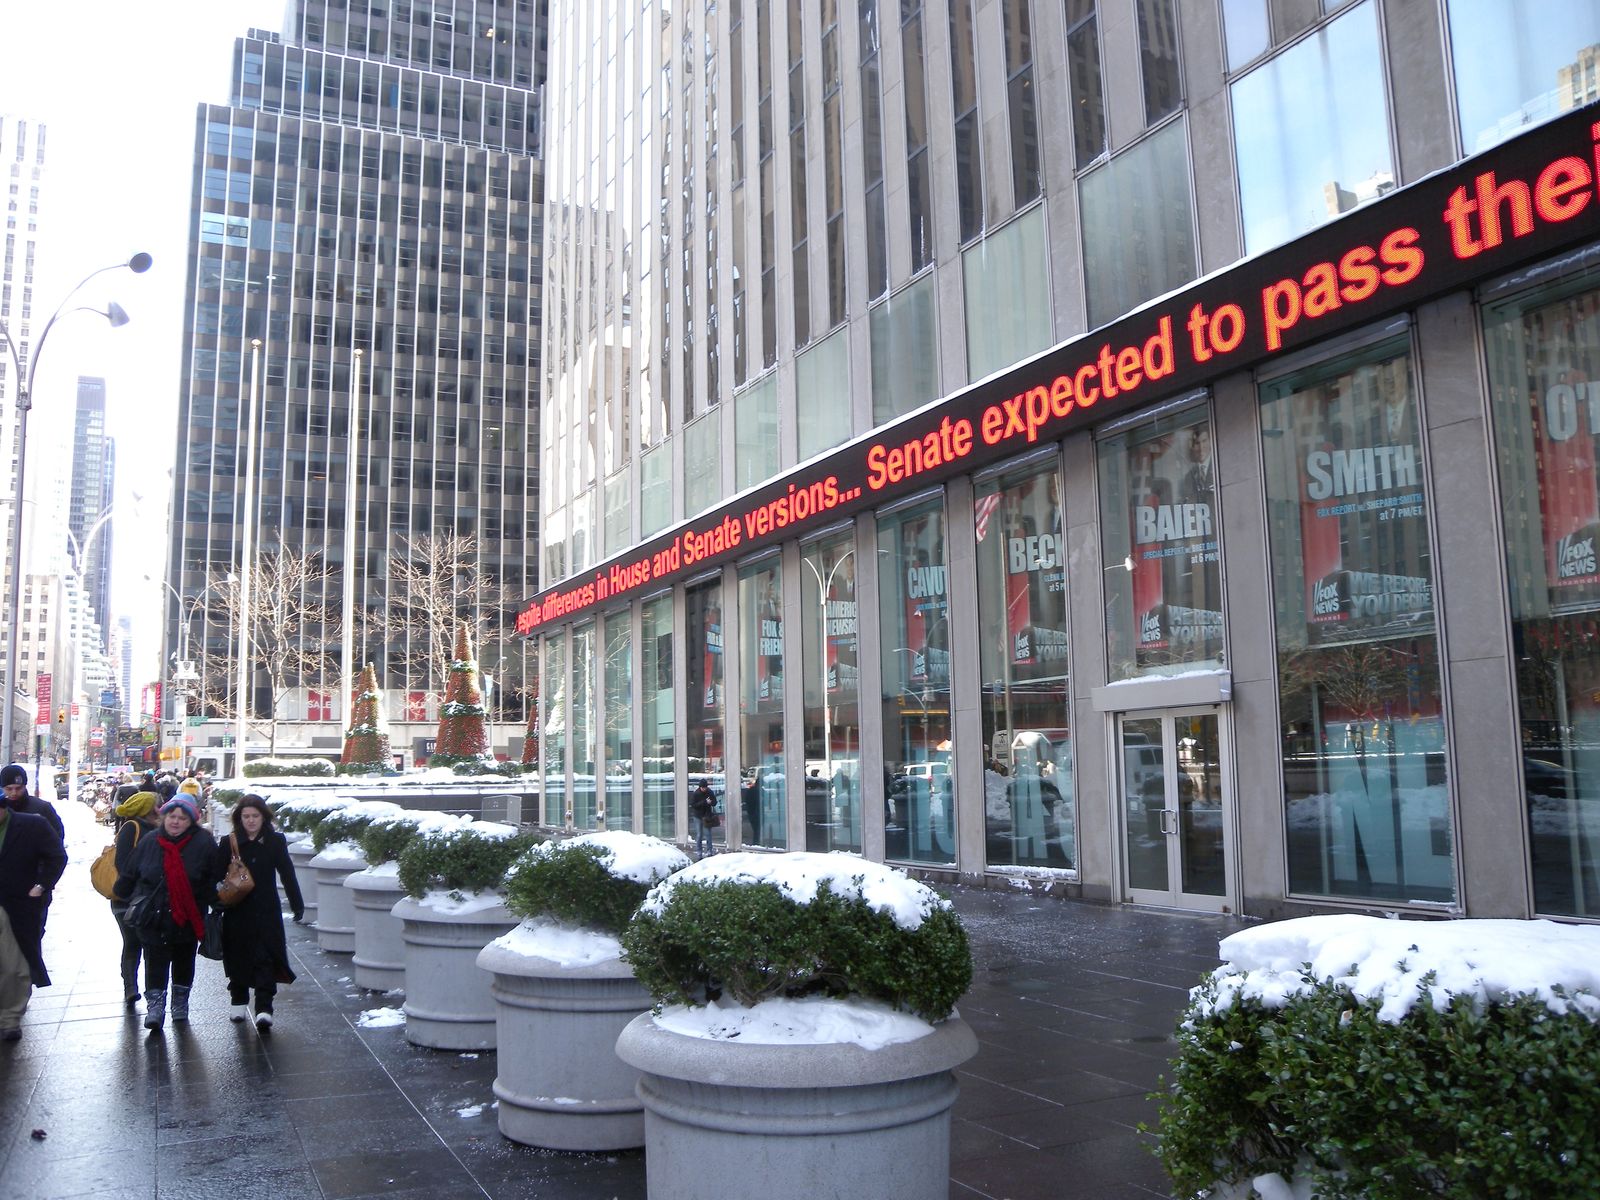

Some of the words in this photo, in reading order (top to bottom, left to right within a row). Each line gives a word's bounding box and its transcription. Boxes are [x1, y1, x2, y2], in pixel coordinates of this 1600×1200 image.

[542, 582, 595, 622] differences
[596, 572, 609, 600] in
[610, 560, 651, 595] House
[652, 537, 681, 579] and
[684, 515, 742, 565] Senate
[745, 476, 862, 539] versions...
[867, 415, 973, 490] Senate
[981, 315, 1175, 442] expected
[1187, 303, 1246, 362] to
[1262, 227, 1425, 350] pass
[1307, 445, 1418, 500] SMITH
[1399, 493, 1423, 505] SMITH
[1380, 511, 1388, 520] at
[1390, 508, 1395, 518] 7
[1398, 506, 1423, 517] PM/ET
[1136, 503, 1212, 545] BAIER
[1567, 537, 1594, 562] FOX
[1191, 555, 1198, 564] at
[1561, 556, 1597, 579] NEWS
[1320, 582, 1338, 601] FOX
[1350, 571, 1379, 593] WE
[1315, 598, 1339, 614] NEWS
[1350, 594, 1391, 618] YOU
[1146, 615, 1160, 631] FOX
[1142, 629, 1161, 642] NEWS
[308, 700, 331, 709] SALE
